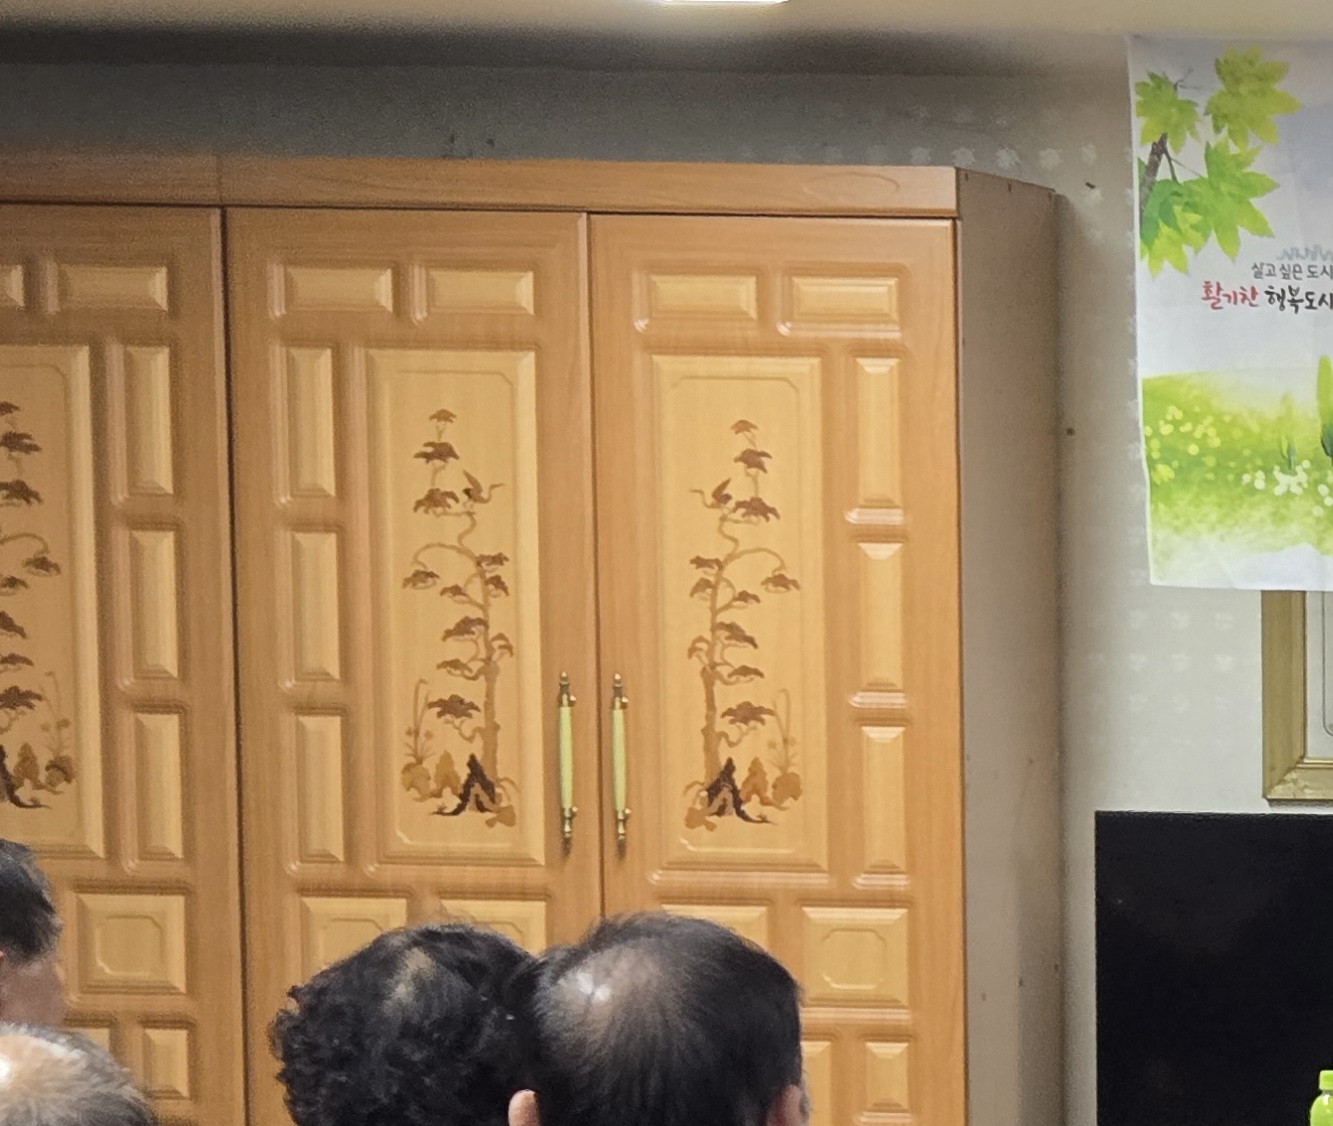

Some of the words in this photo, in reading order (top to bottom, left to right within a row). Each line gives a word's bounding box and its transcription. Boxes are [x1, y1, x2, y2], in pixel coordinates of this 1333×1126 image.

[1251, 262, 1276, 280] 살고
[1279, 263, 1303, 280] 싶은
[1201, 280, 1260, 310] 활기찬
[1264, 285, 1333, 314] 행복도시
